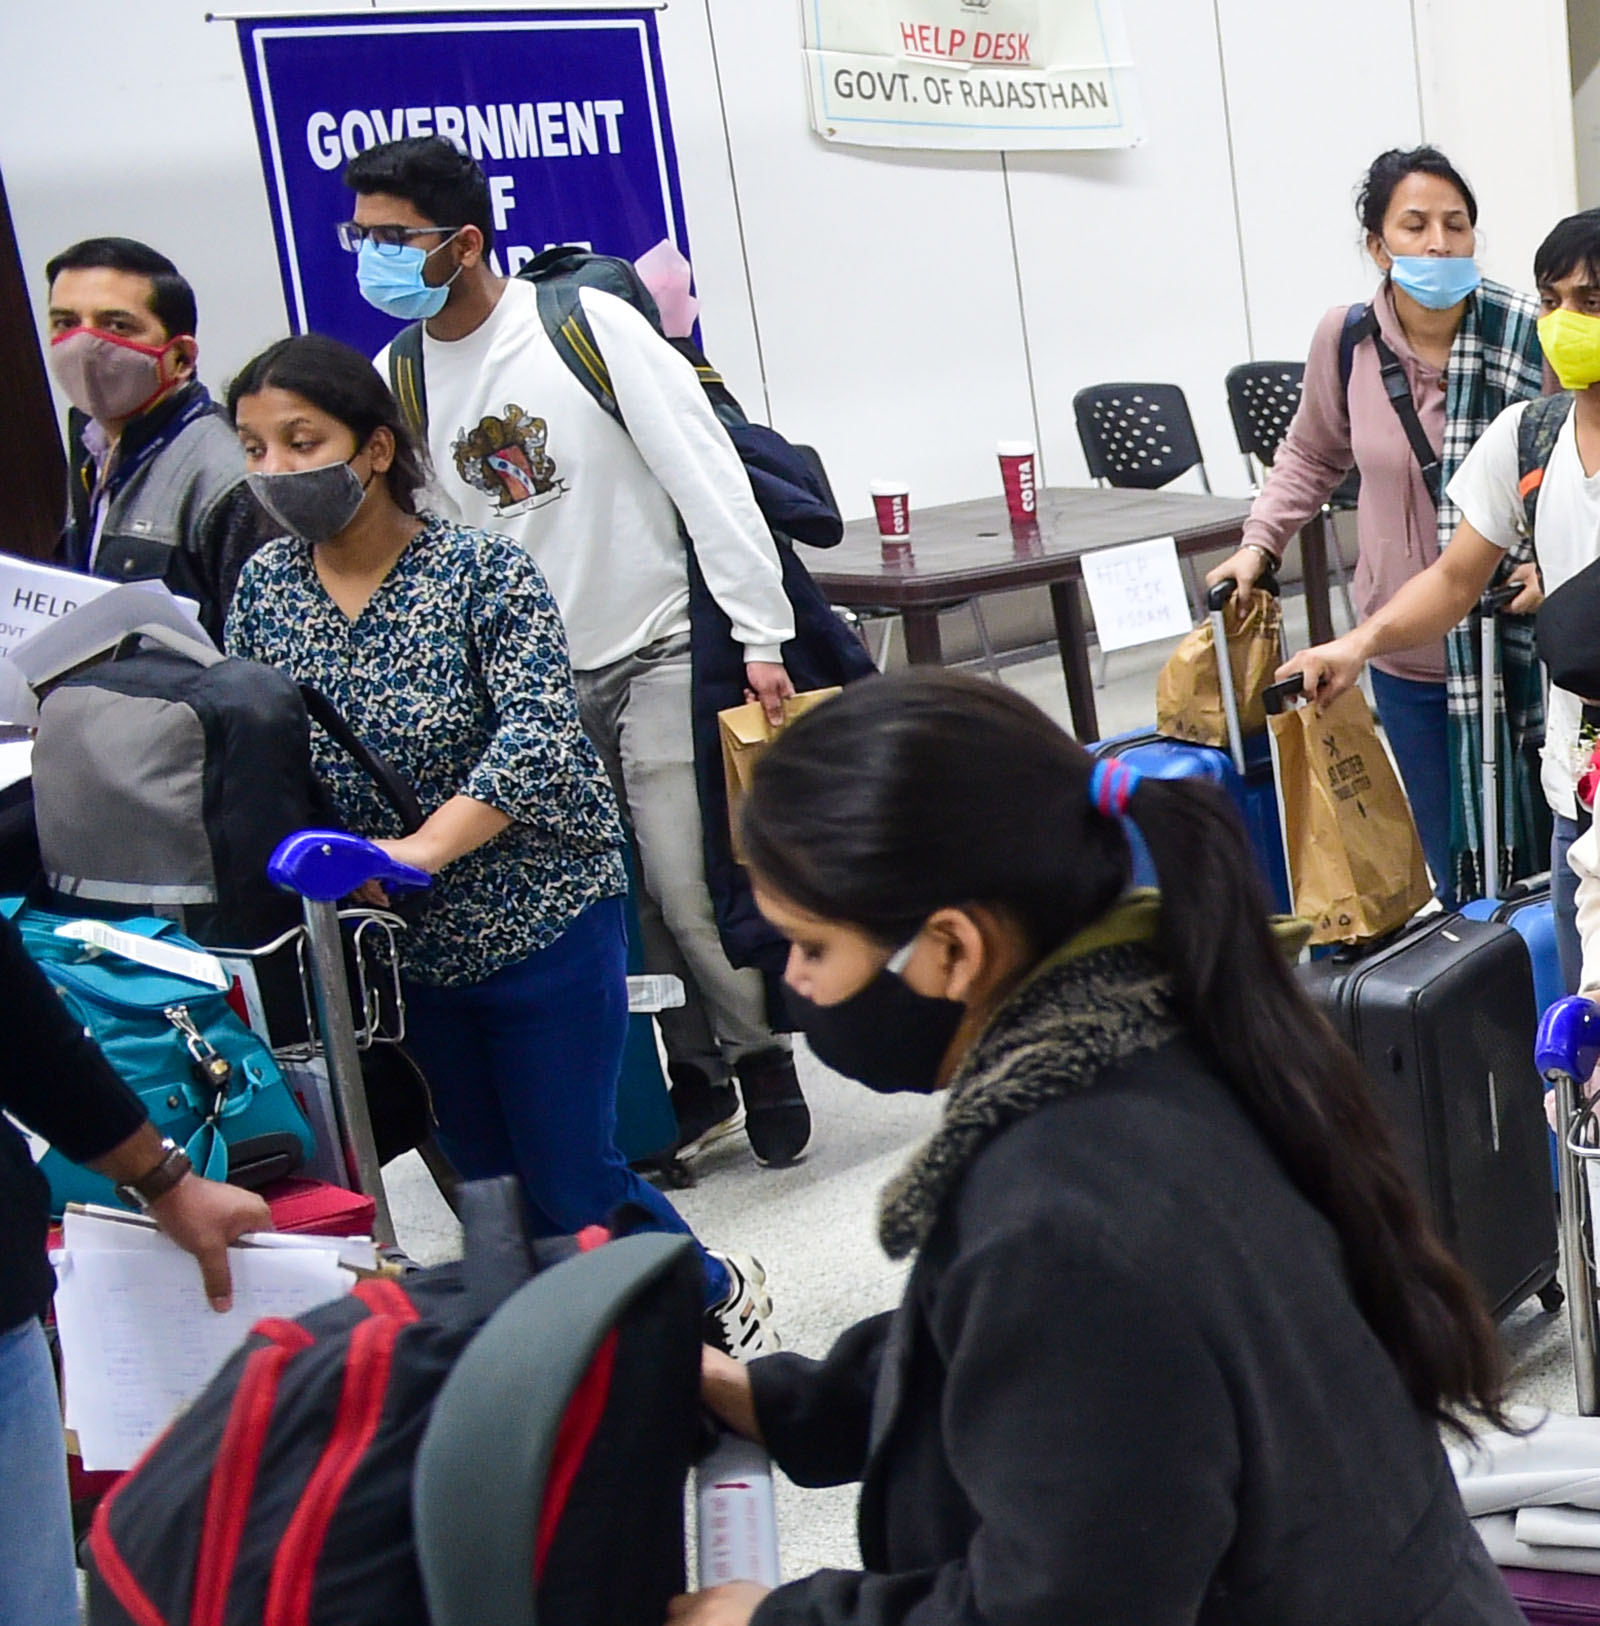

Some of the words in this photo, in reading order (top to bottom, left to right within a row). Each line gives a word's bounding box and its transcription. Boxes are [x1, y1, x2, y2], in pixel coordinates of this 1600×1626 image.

[900, 22, 966, 57] HELP
[972, 33, 1031, 61] DESK
[834, 69, 918, 103] GOVT.
[924, 76, 953, 105] OF
[959, 79, 1109, 109] RAJASTHAN
[493, 176, 516, 231] F
[1018, 460, 1035, 513] COSTA
